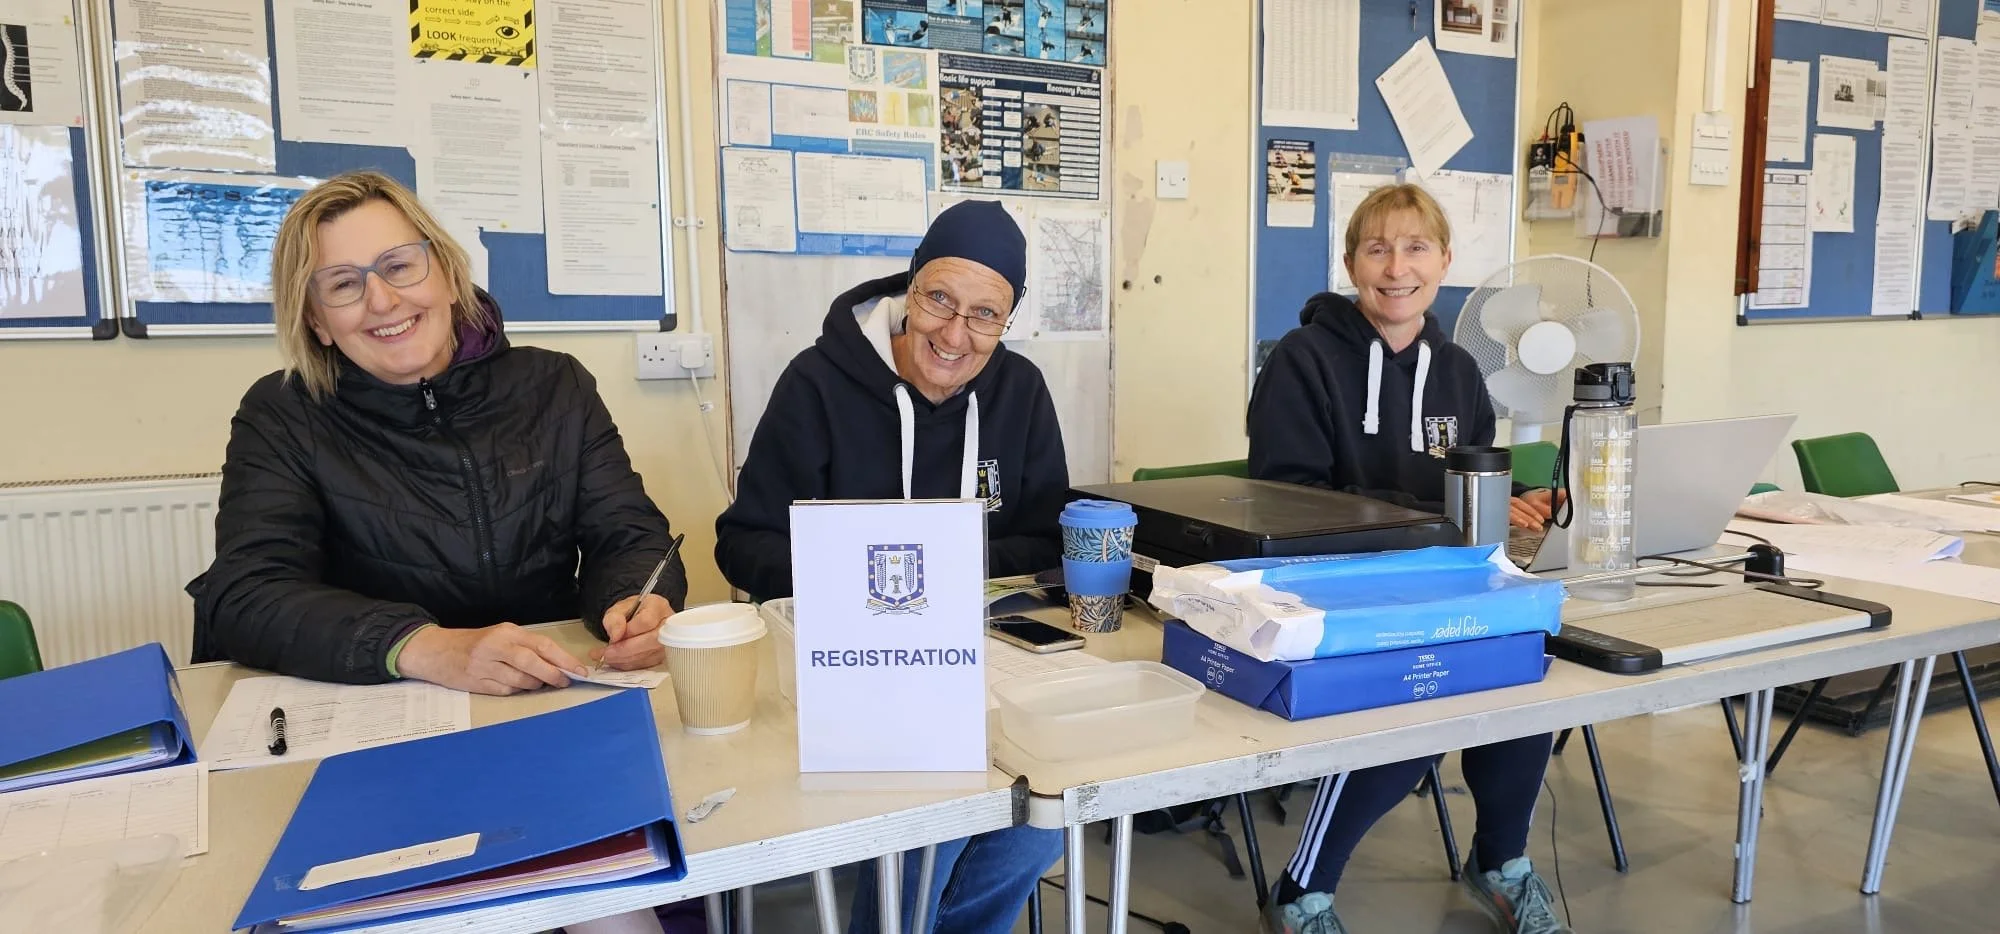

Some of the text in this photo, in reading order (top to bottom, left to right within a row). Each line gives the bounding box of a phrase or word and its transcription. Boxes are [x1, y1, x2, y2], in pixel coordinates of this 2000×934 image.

[425, 6, 475, 17] correct side
[426, 30, 503, 46] LOOK frequently
[940, 73, 957, 82] Basic
[970, 78, 996, 87] support
[1047, 83, 1100, 97] Recovery Position
[876, 129, 900, 139] Safety
[903, 131, 927, 139] Rules
[1431, 616, 1489, 639] copy paper
[811, 648, 976, 667] REGISTRATION
[1200, 655, 1236, 674] A4 Printer Paper
[1403, 670, 1450, 682] A4 Printer Paper
